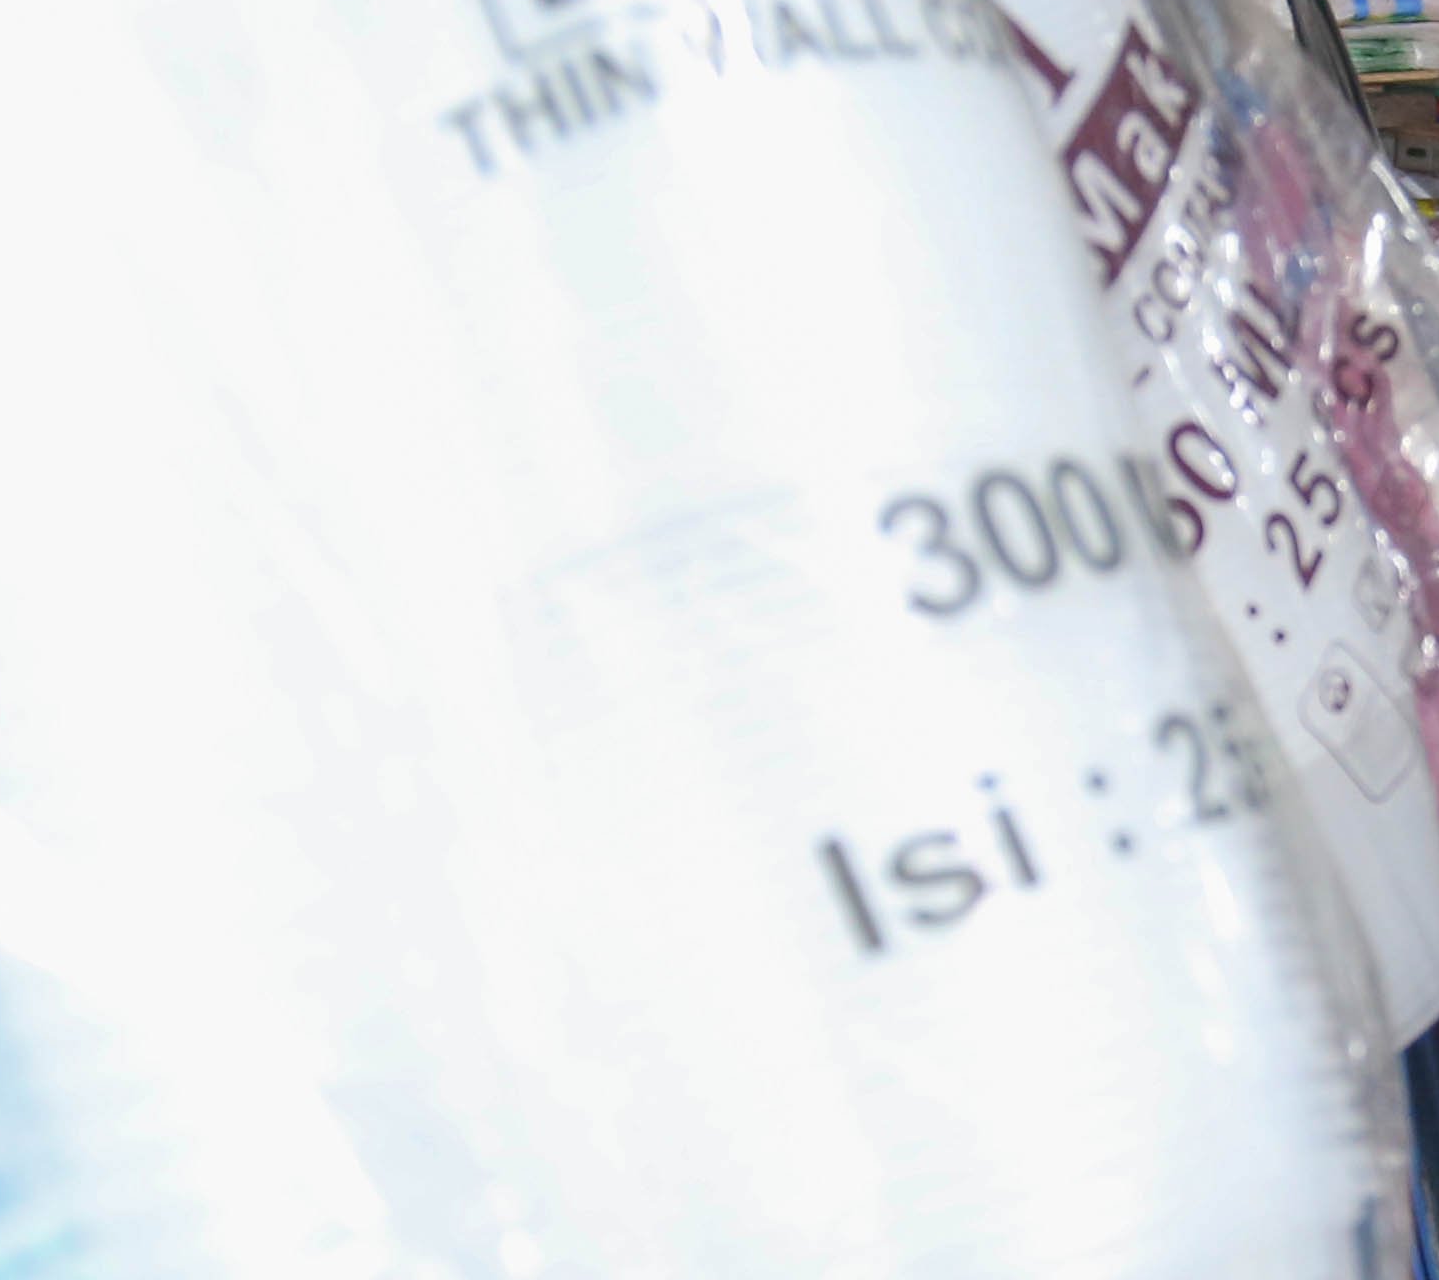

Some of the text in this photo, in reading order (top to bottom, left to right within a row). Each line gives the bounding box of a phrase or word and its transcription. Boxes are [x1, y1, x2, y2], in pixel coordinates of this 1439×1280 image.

[443, 35, 660, 178] THIN
[1263, 450, 1347, 594] 25
[814, 768, 1041, 958] Isi
